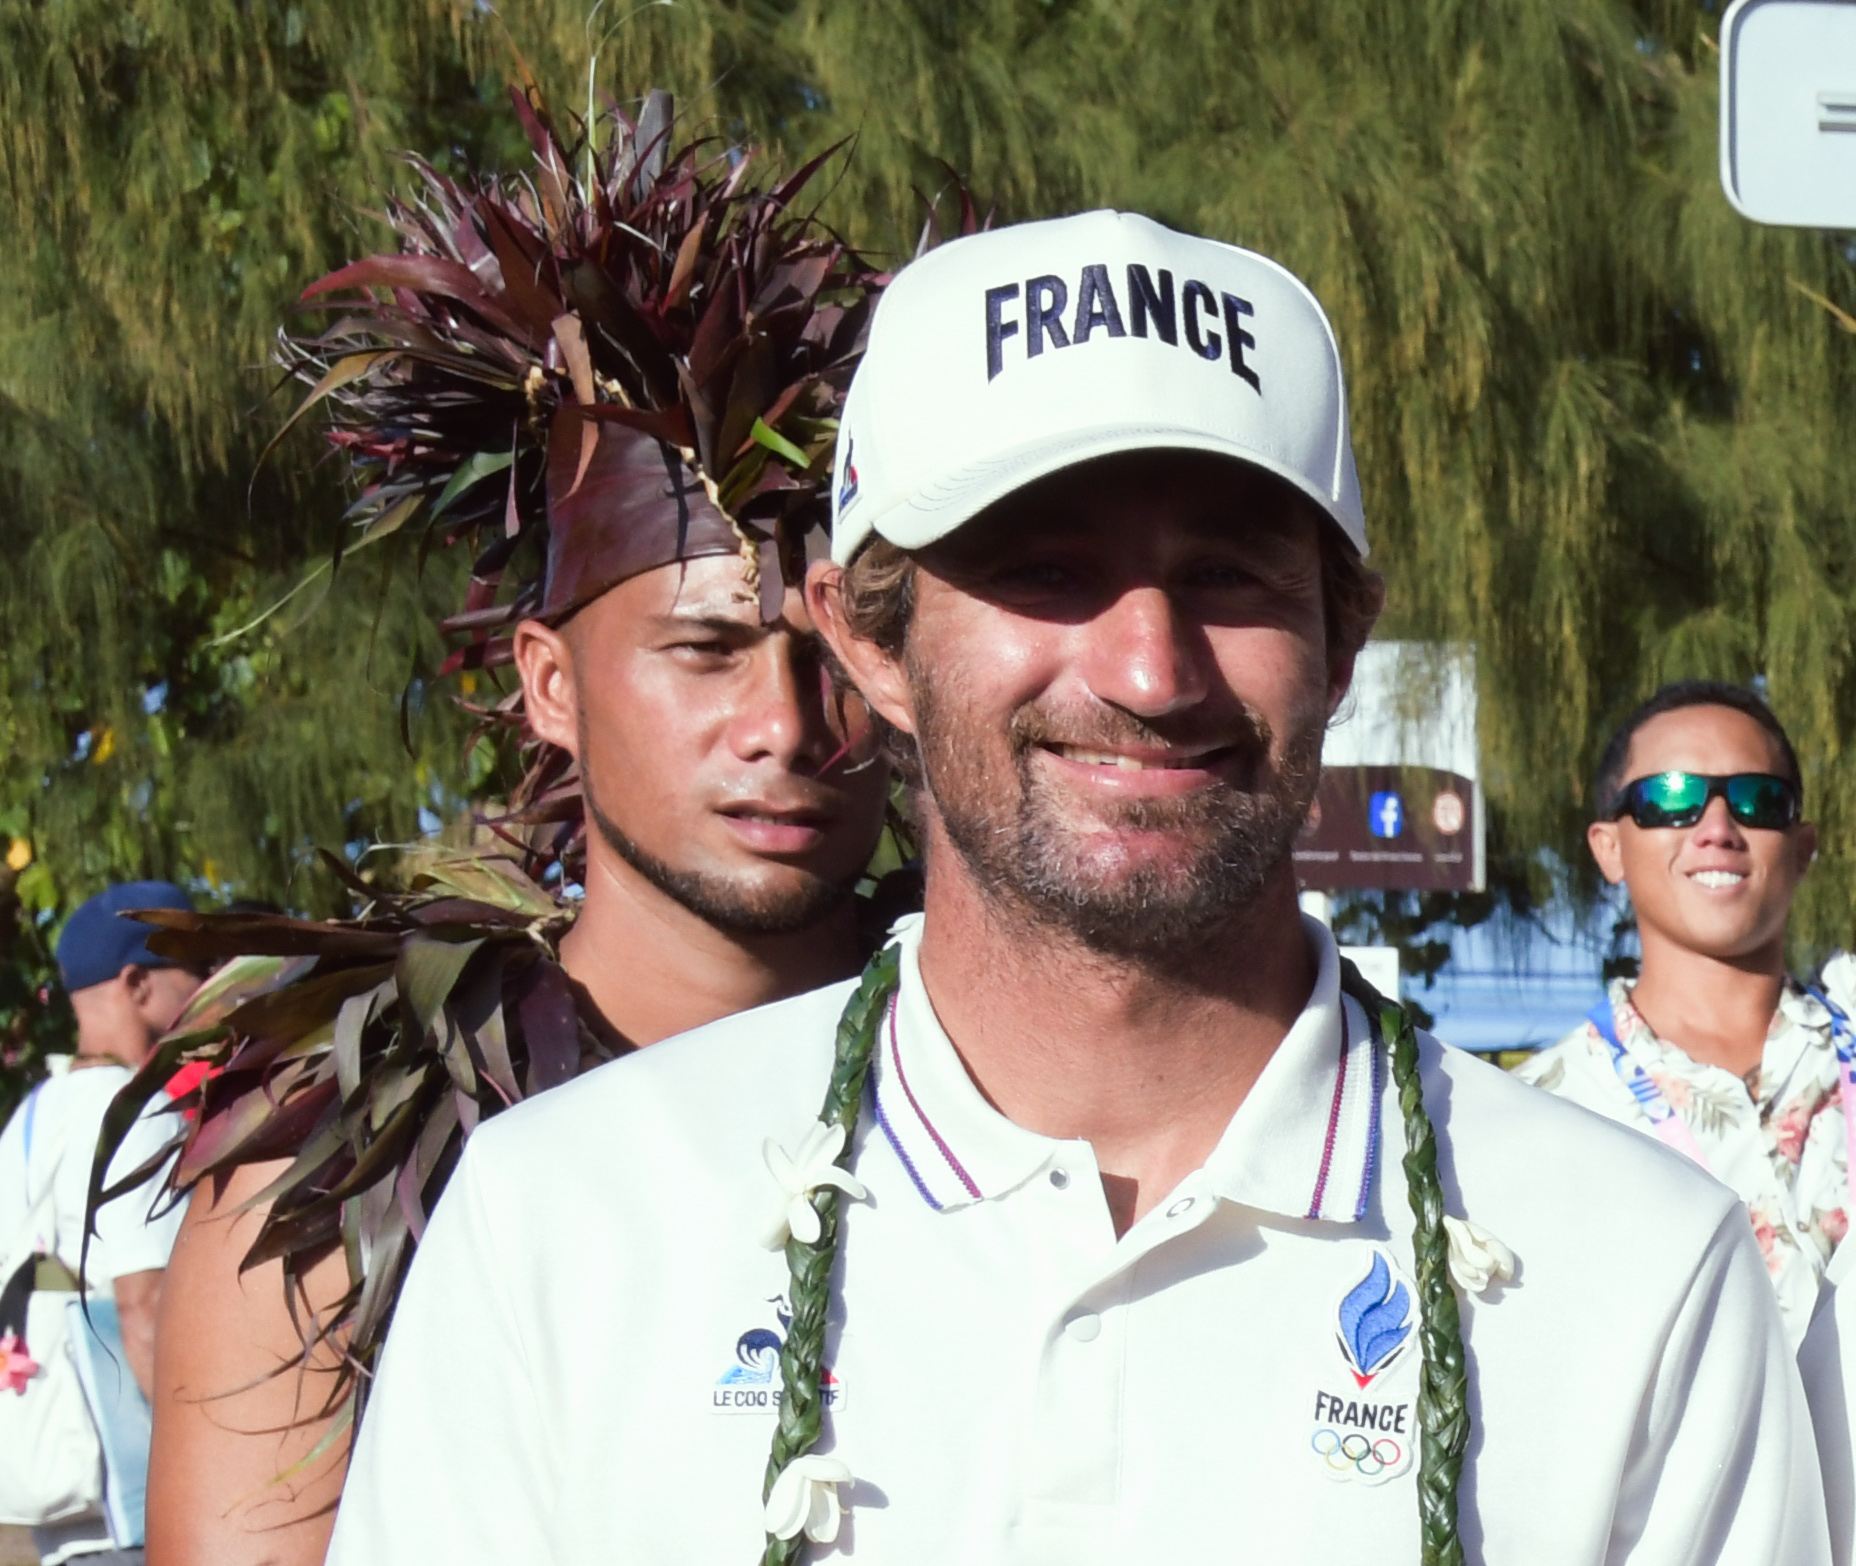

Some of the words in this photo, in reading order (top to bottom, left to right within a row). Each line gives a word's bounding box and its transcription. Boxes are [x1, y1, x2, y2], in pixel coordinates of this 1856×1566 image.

[985, 264, 1262, 396] FRANCE
[713, 1391, 732, 1406] LE
[734, 1390, 768, 1407] COQ
[1314, 1390, 1409, 1434] FRANCE
